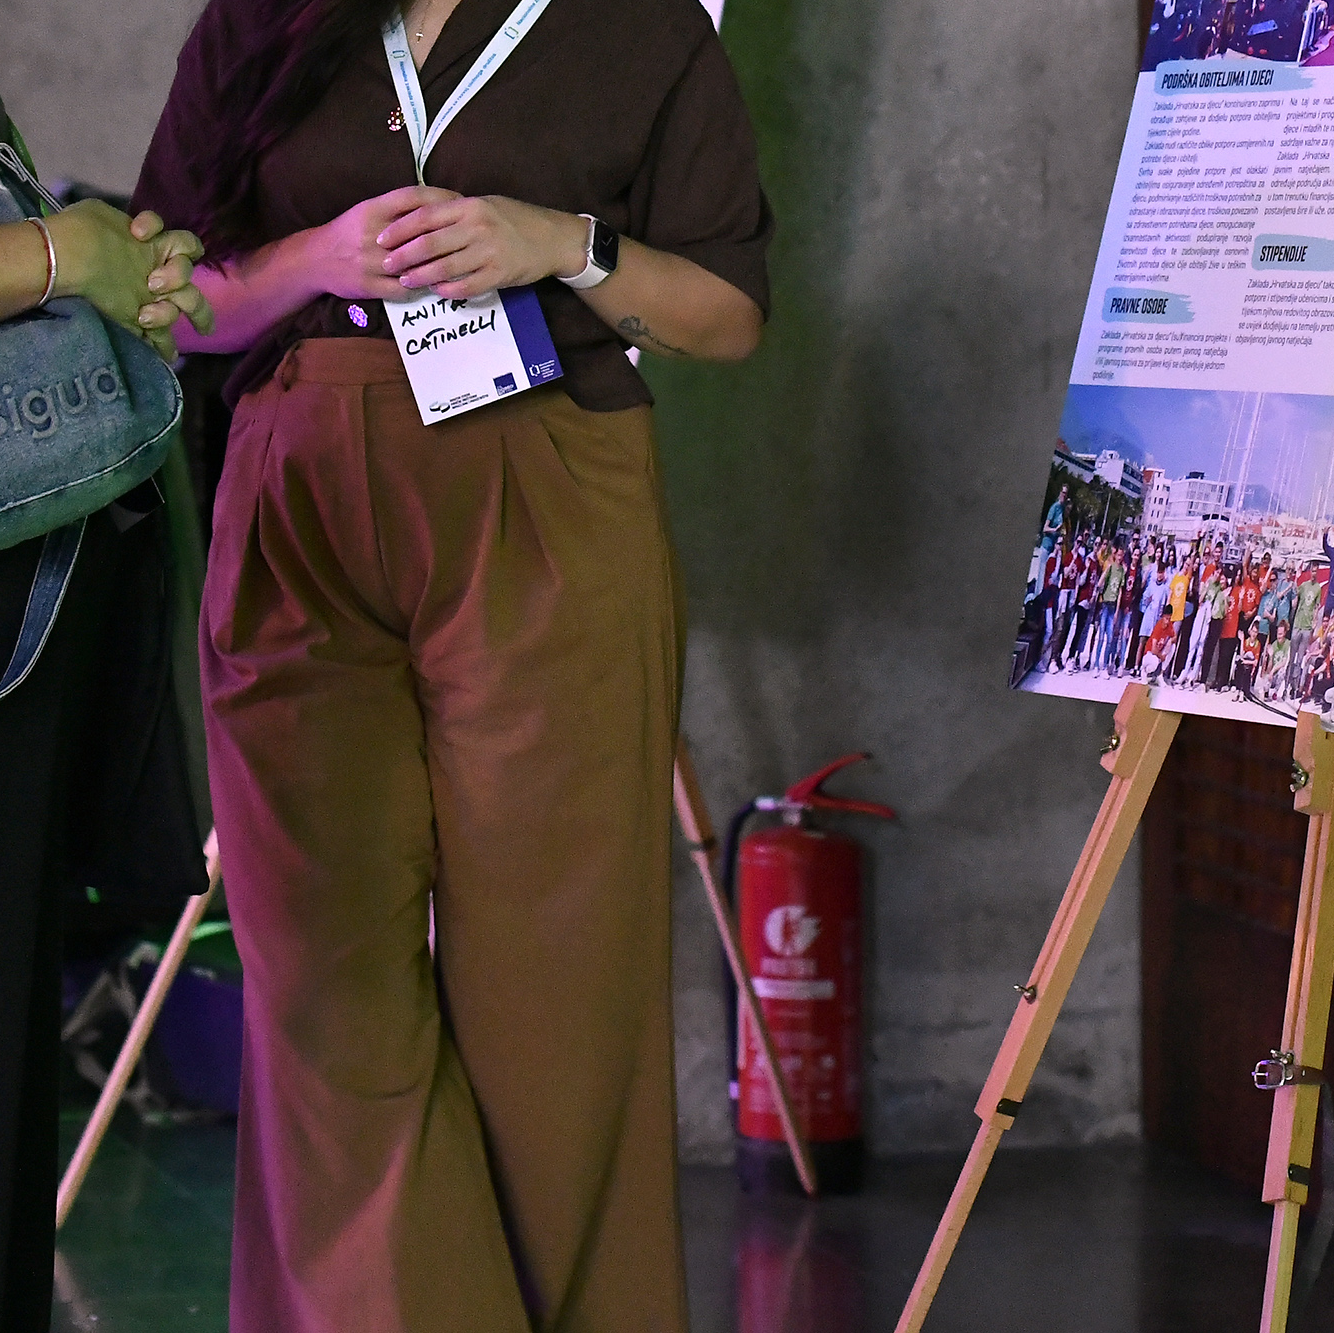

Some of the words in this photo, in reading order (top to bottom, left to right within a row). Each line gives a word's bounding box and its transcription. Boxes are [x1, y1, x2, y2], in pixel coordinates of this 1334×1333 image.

[1161, 69, 1199, 90] PODRŠKA
[1199, 70, 1245, 88] OBITELJIMA
[1249, 69, 1275, 86] DJECI
[1259, 245, 1308, 263] STIPENDIJE
[1109, 297, 1142, 314] PRAVNE
[1140, 297, 1169, 315] OSOBE
[406, 310, 496, 356] CATINELLI
